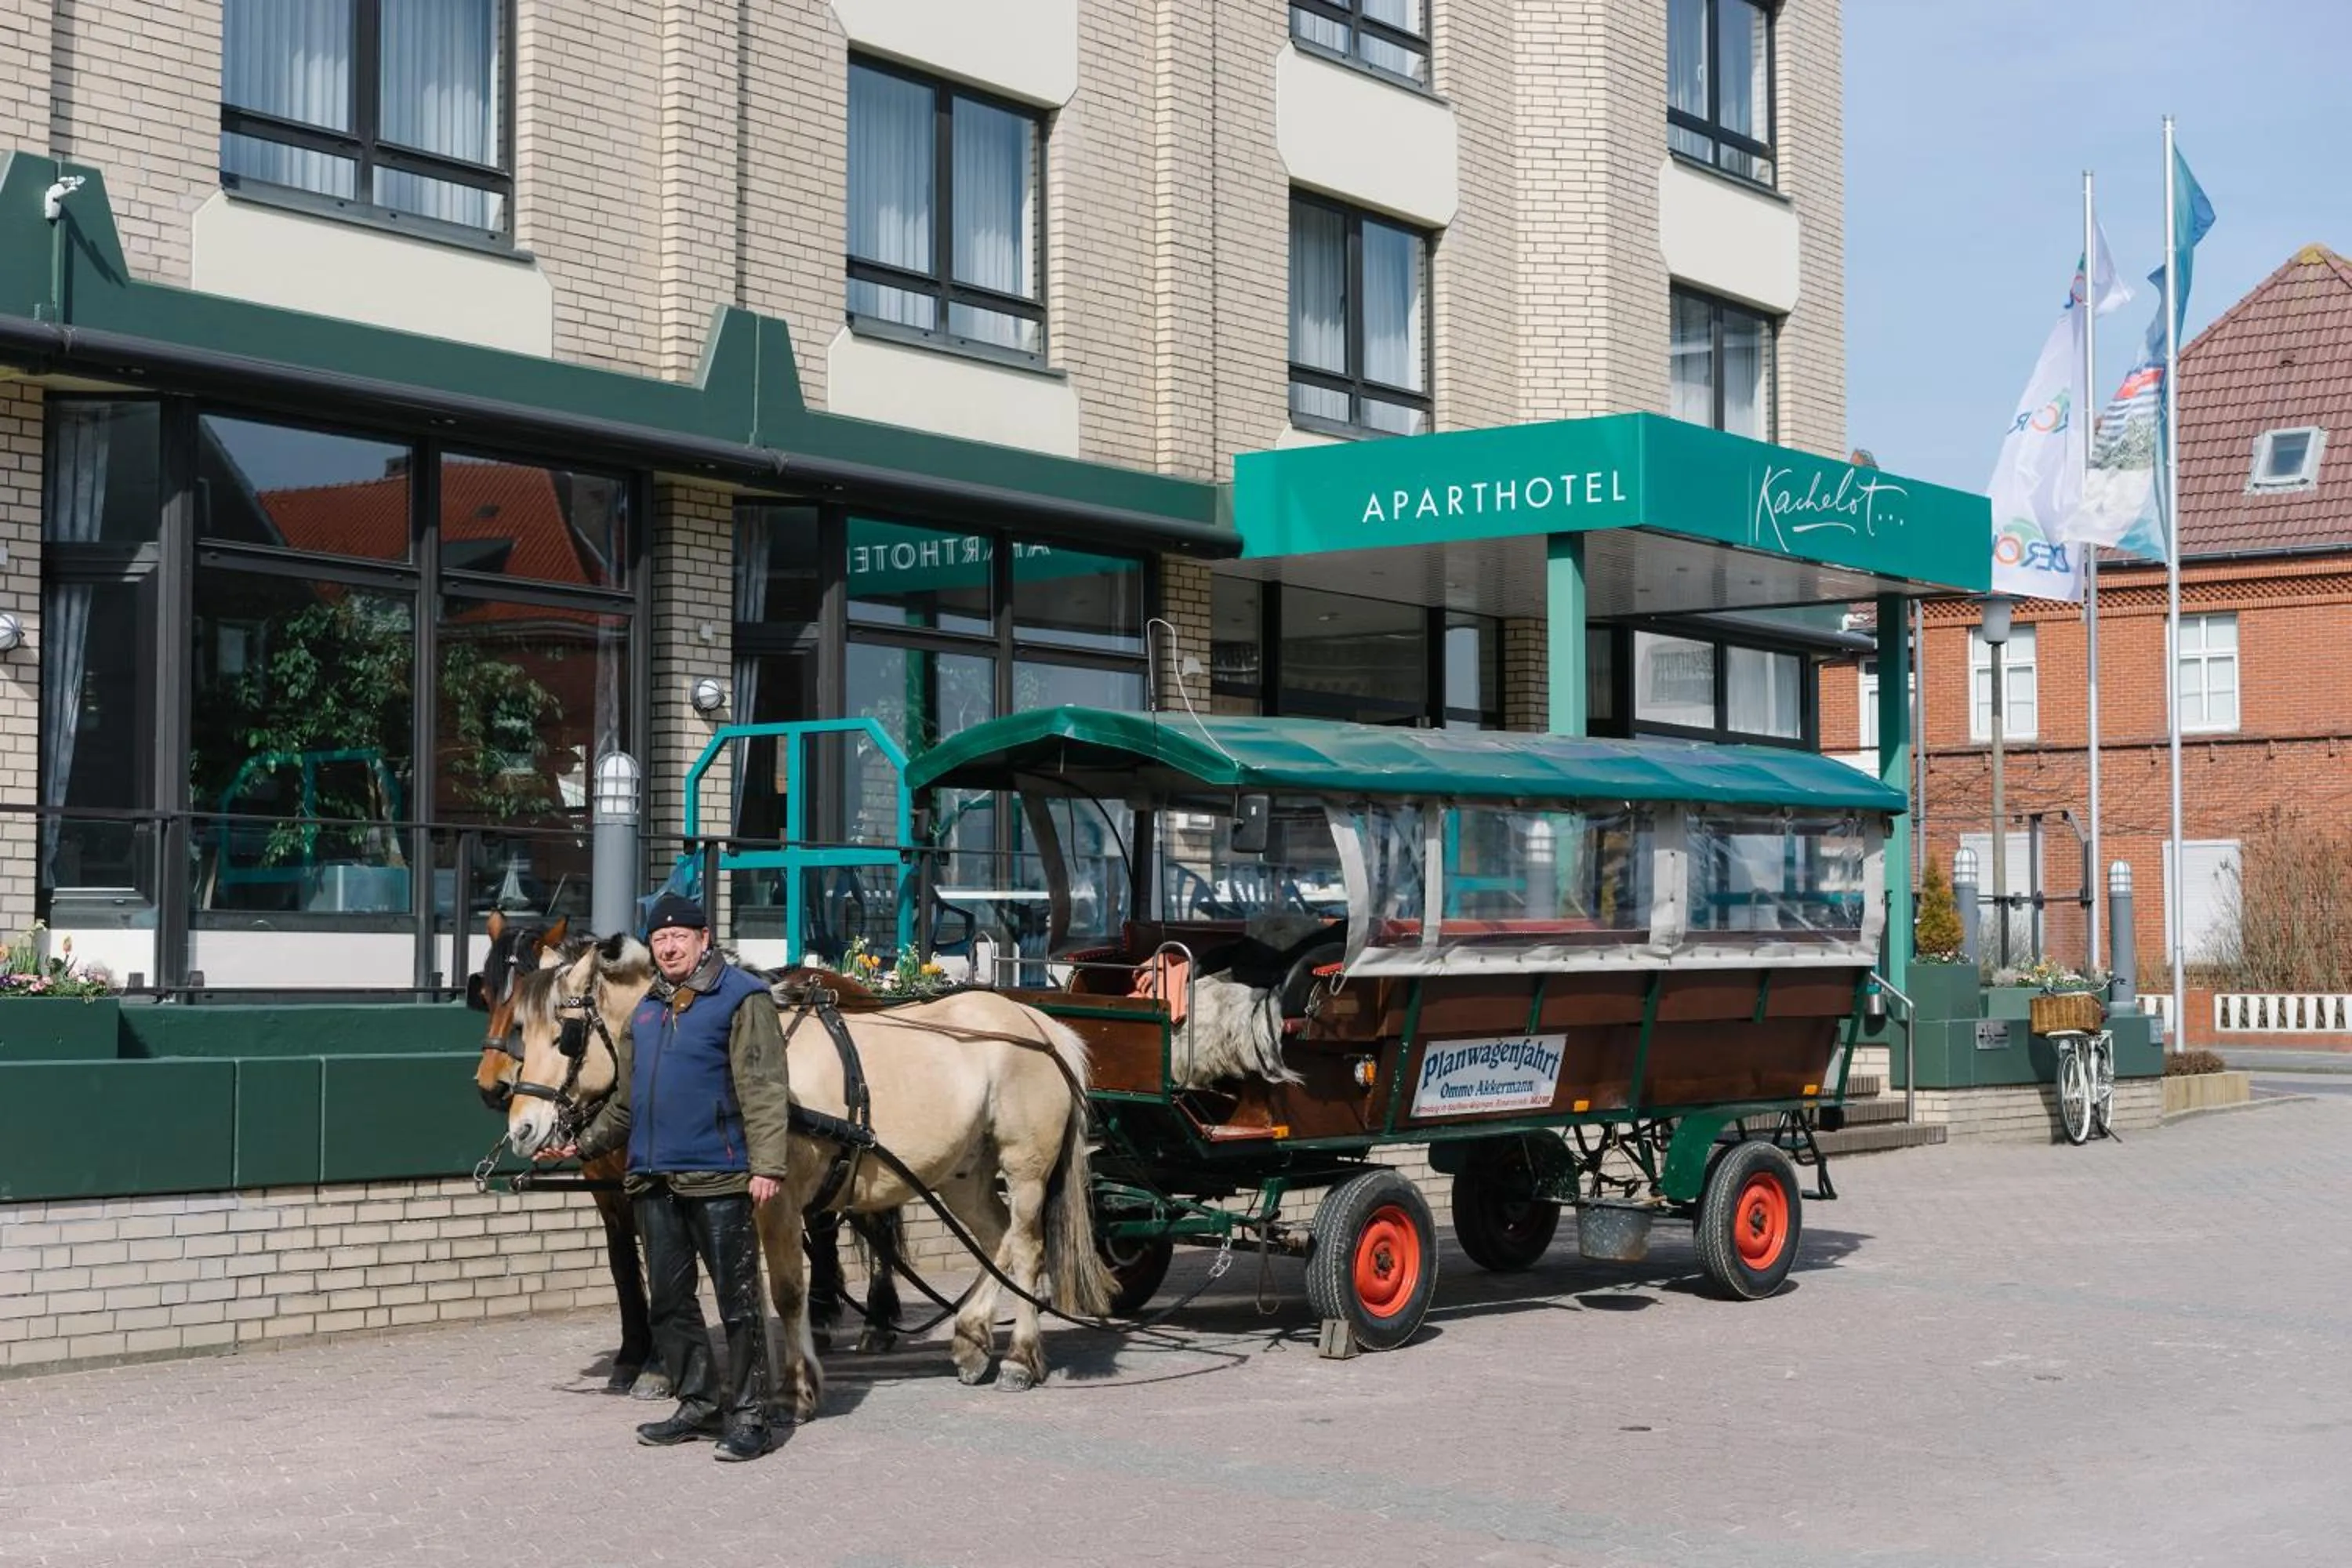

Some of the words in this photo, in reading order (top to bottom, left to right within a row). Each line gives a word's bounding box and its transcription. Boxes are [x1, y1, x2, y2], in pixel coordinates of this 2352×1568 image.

[1362, 470, 1626, 523] APARTHOTEL
[1422, 1038, 1559, 1090] Planwagenfahrt
[1440, 1082, 1473, 1098] Ommo
[1475, 1079, 1534, 1097] Akkermann
